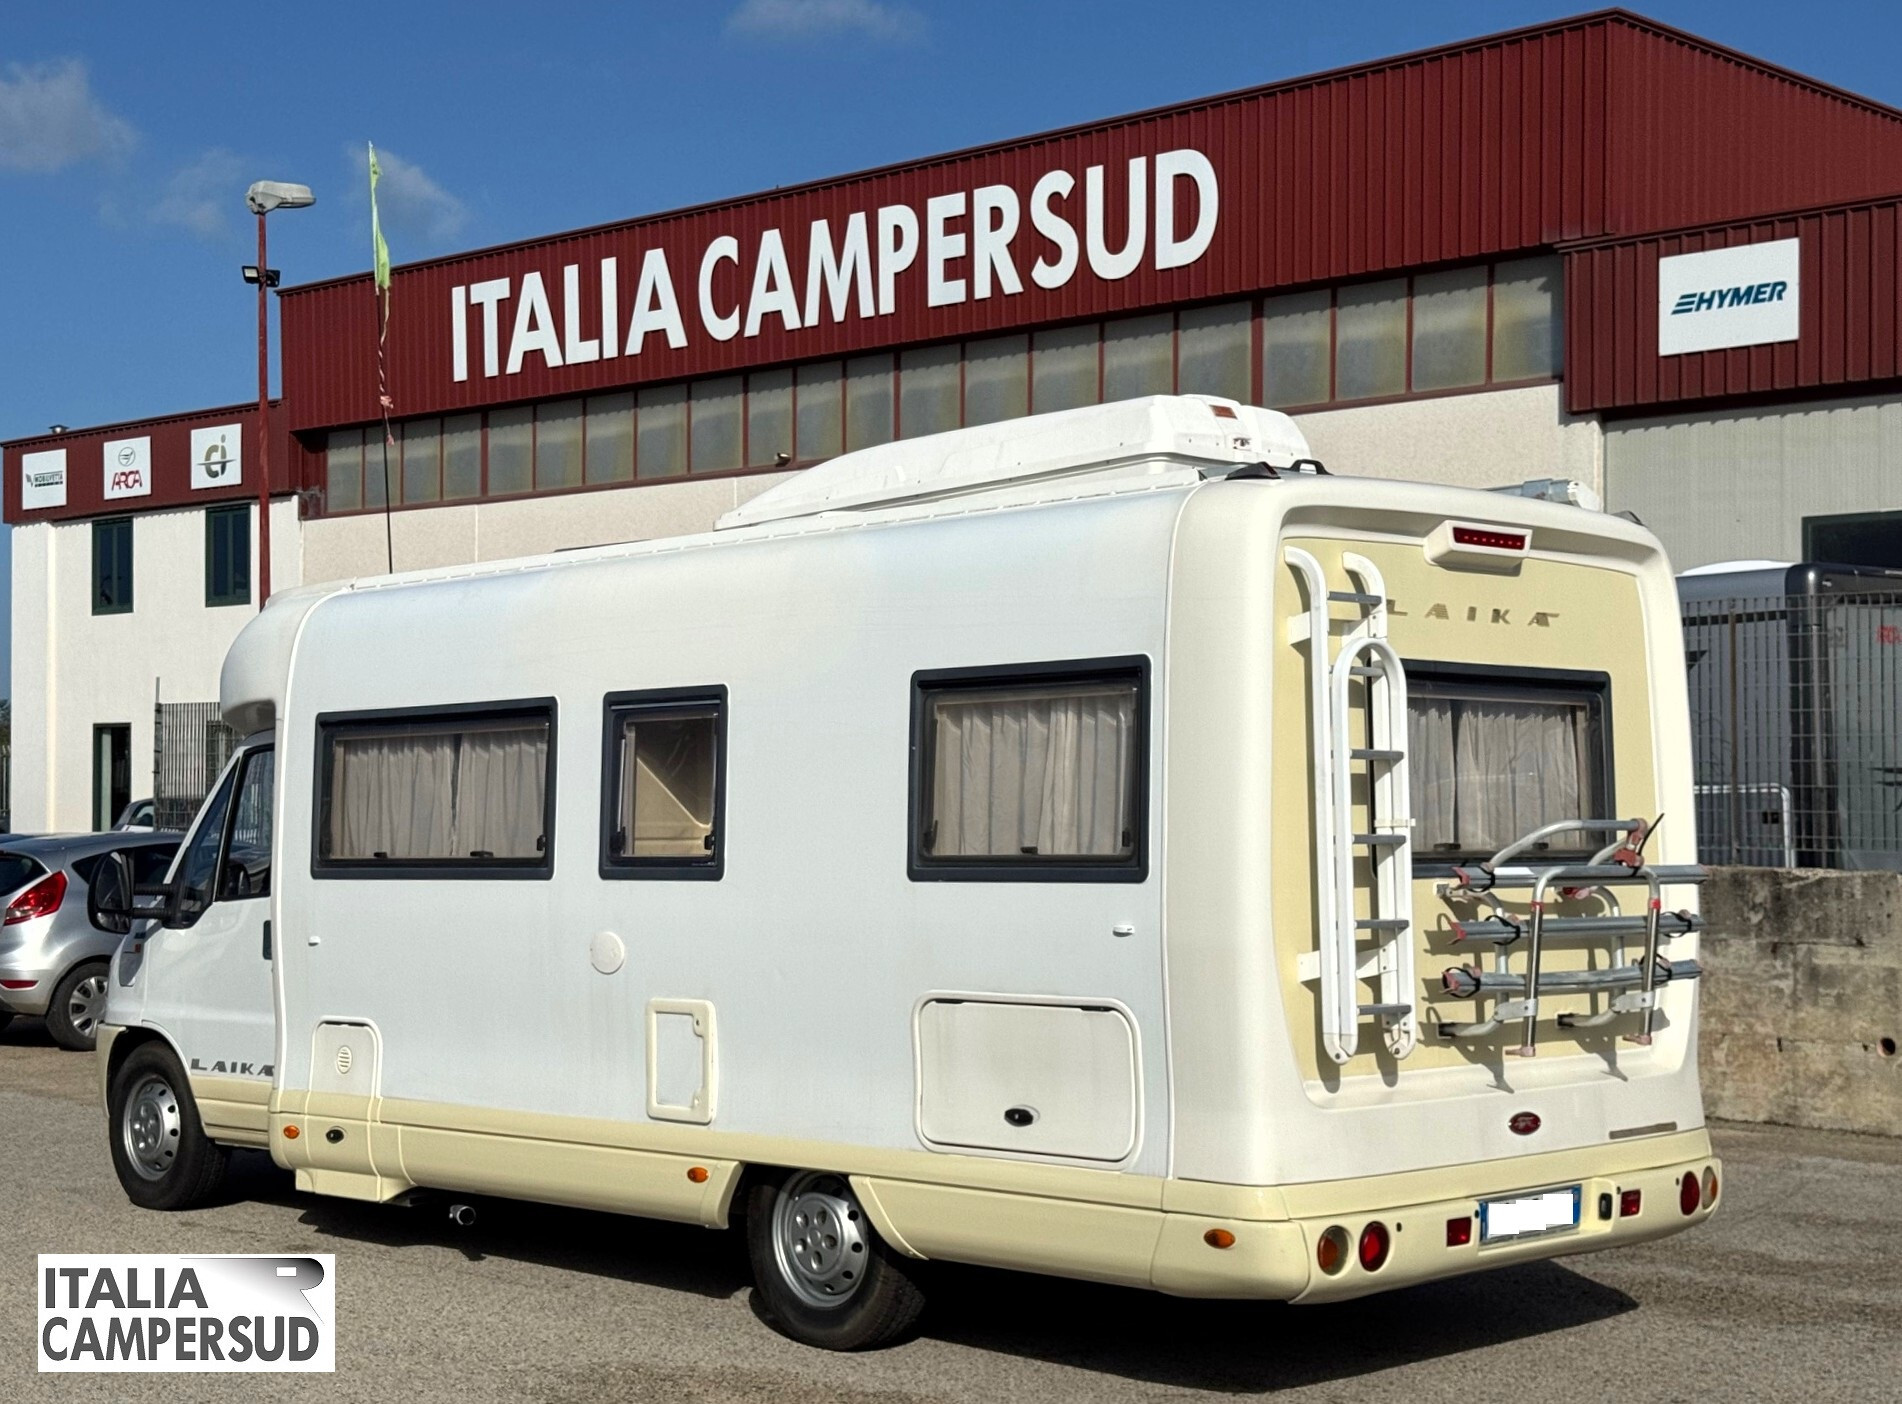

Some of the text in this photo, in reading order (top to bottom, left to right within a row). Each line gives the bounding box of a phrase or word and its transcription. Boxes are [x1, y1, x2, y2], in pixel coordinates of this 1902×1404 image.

[452, 148, 1220, 382] ITALIA CAMPERSUD
[1694, 280, 1788, 312] HYMER
[111, 469, 143, 491] ARCA
[1386, 598, 1560, 628] LAIKA
[190, 1058, 275, 1077] LAIKA
